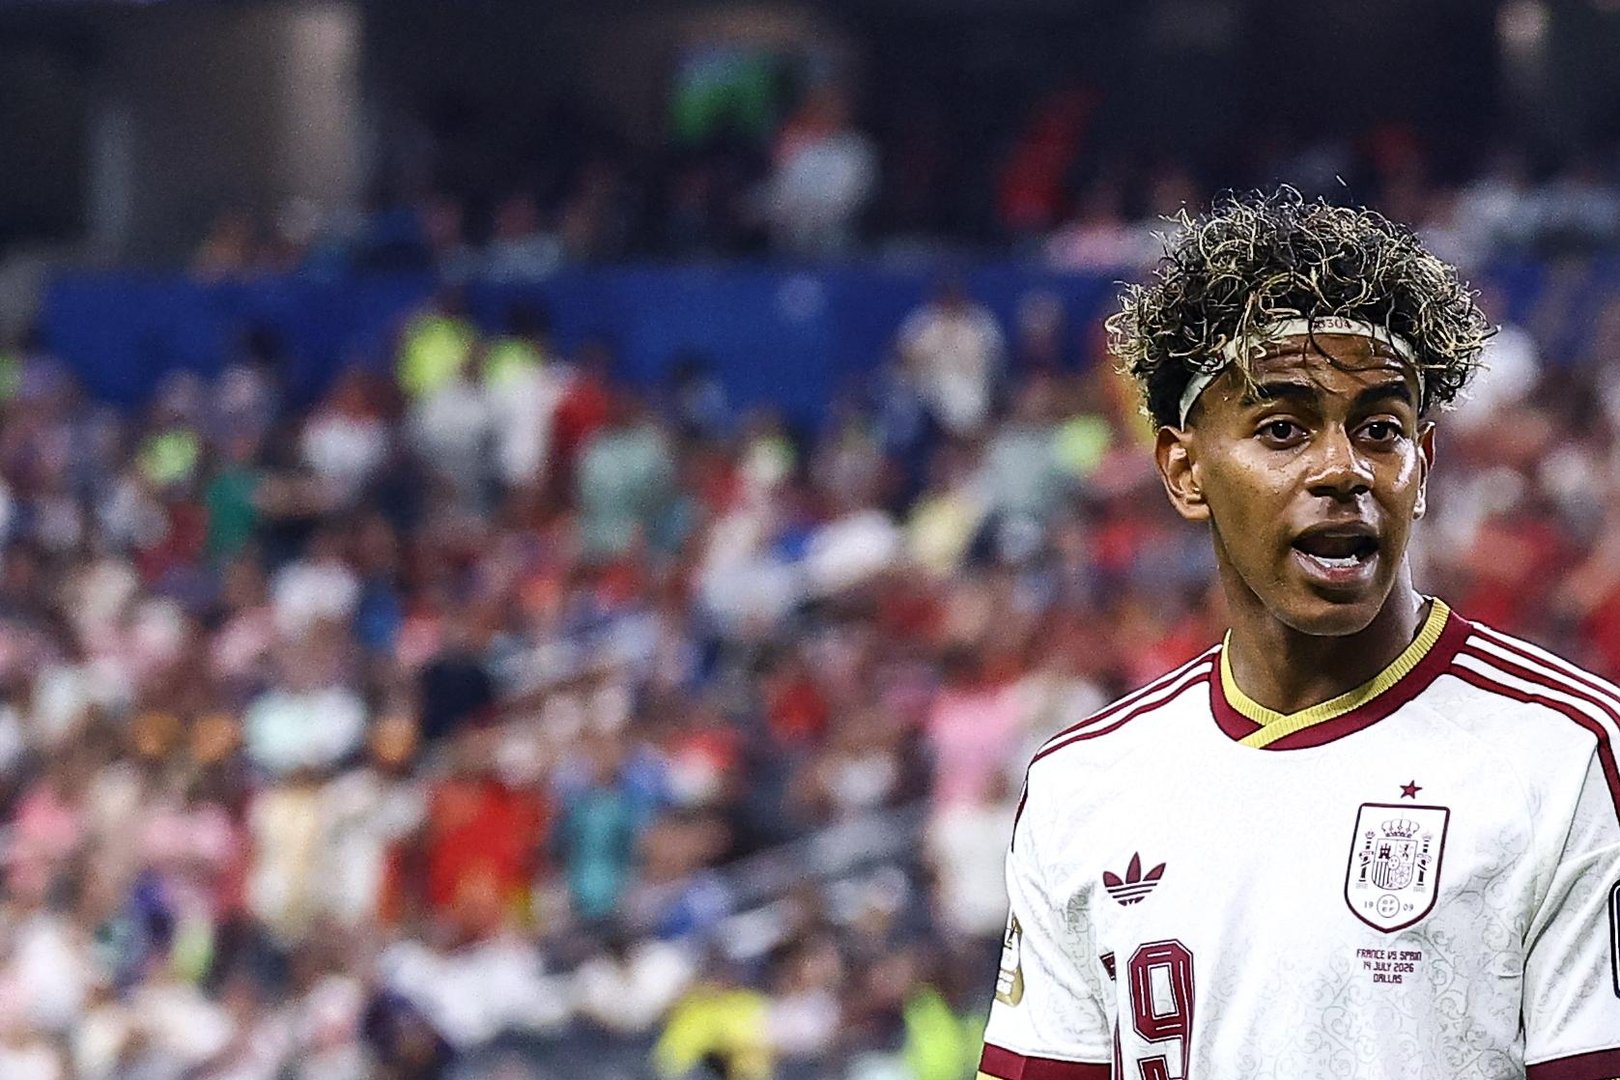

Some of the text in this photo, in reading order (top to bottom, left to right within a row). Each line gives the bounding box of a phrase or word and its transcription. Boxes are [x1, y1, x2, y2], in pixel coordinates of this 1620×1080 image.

[1357, 949, 1422, 961] FRANCE VS SPAIN
[1373, 961, 1391, 971] JULY
[1394, 963, 1414, 973] 2026
[1373, 973, 1402, 984] DALLAS
